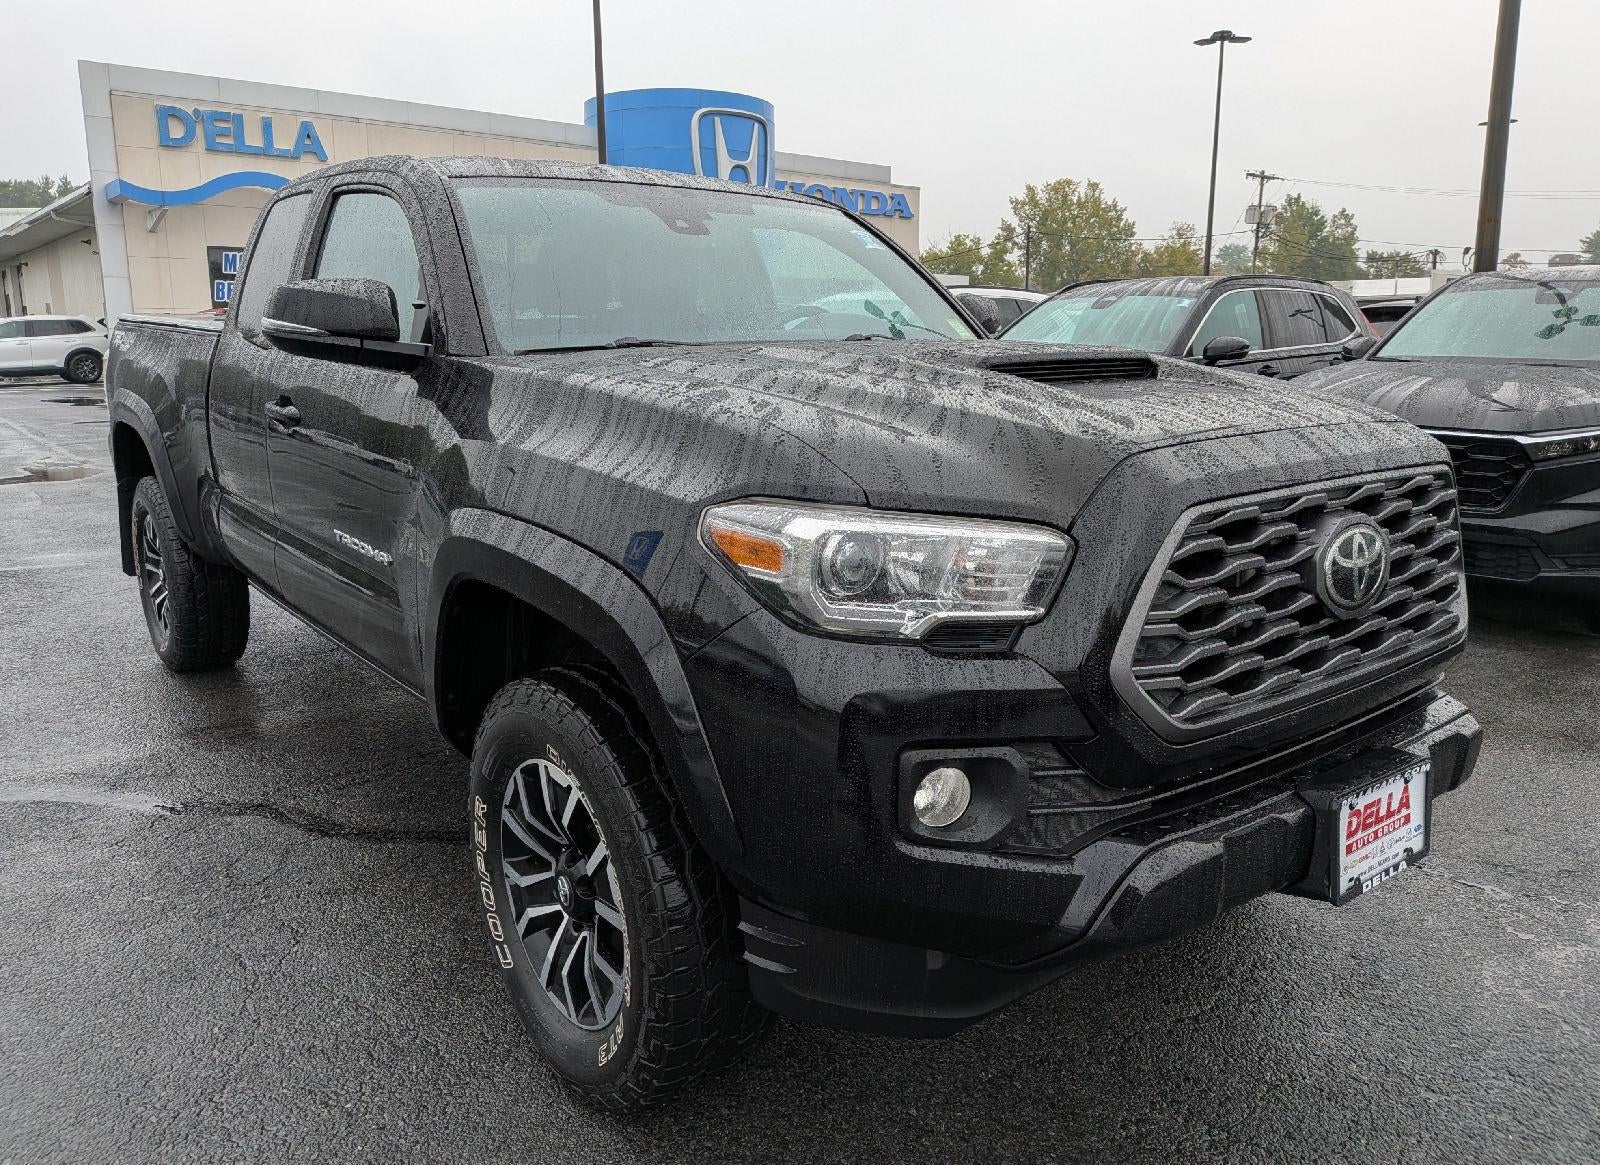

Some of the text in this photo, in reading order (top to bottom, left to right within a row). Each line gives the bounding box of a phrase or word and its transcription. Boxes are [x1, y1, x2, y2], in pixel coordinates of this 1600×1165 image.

[155, 103, 329, 162] D'ELLA
[333, 528, 393, 566] TACOMA
[1346, 784, 1411, 841] DELLA
[1351, 833, 1375, 852] AUTO
[1377, 817, 1405, 838] GROUP
[474, 795, 514, 968] COOPER
[1362, 860, 1408, 893] DELLA
